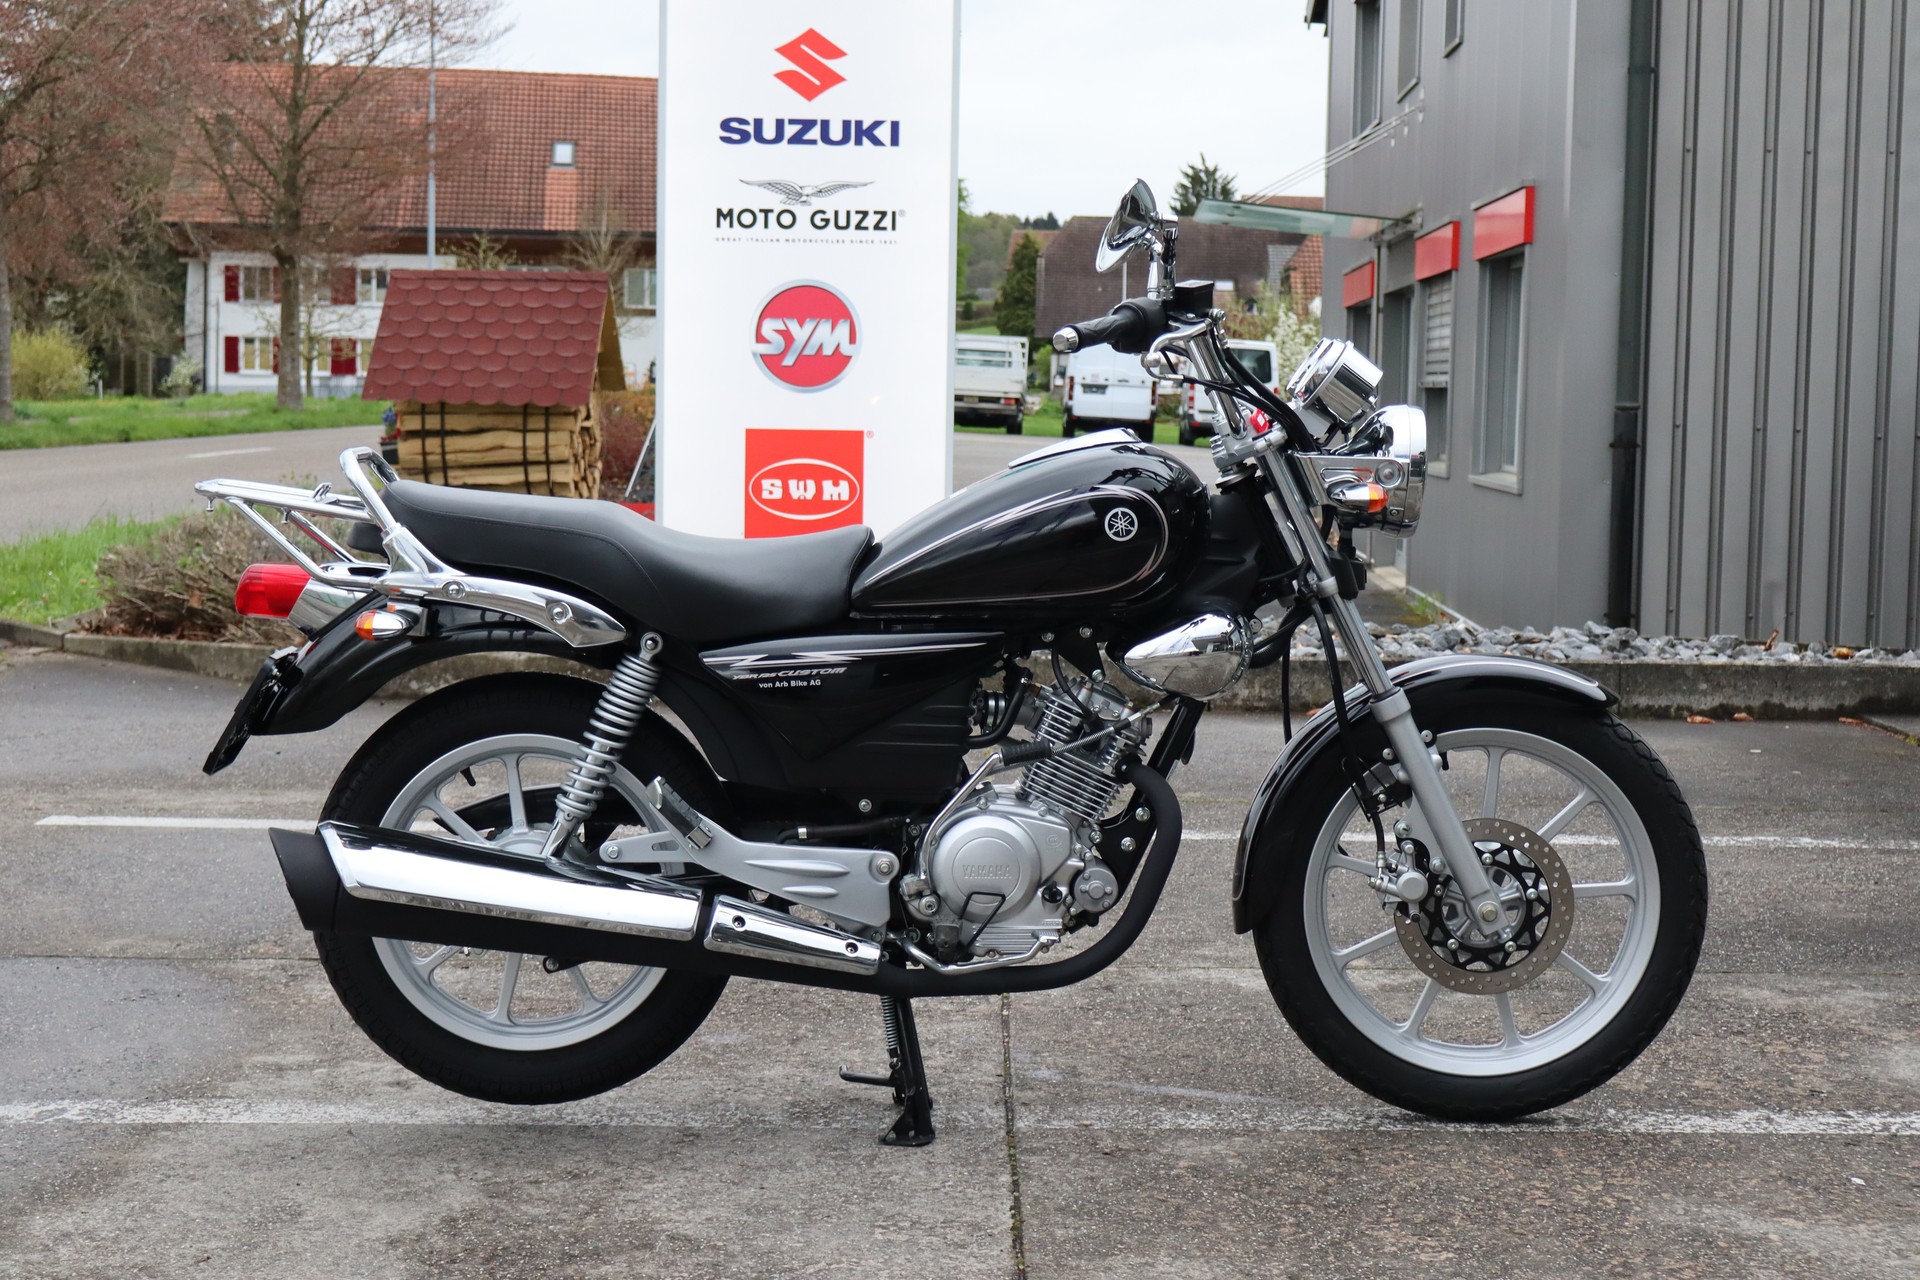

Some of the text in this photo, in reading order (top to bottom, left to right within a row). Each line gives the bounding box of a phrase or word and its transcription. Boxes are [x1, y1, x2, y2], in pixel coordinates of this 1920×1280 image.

[718, 116, 900, 147] SUZUKI
[716, 208, 897, 231] MOTO GUZZI
[751, 317, 857, 367] SYM
[760, 478, 851, 502] SWM
[778, 667, 847, 677] CUSTOM
[774, 680, 789, 688] Arb
[962, 863, 1012, 879] YAMAHA
